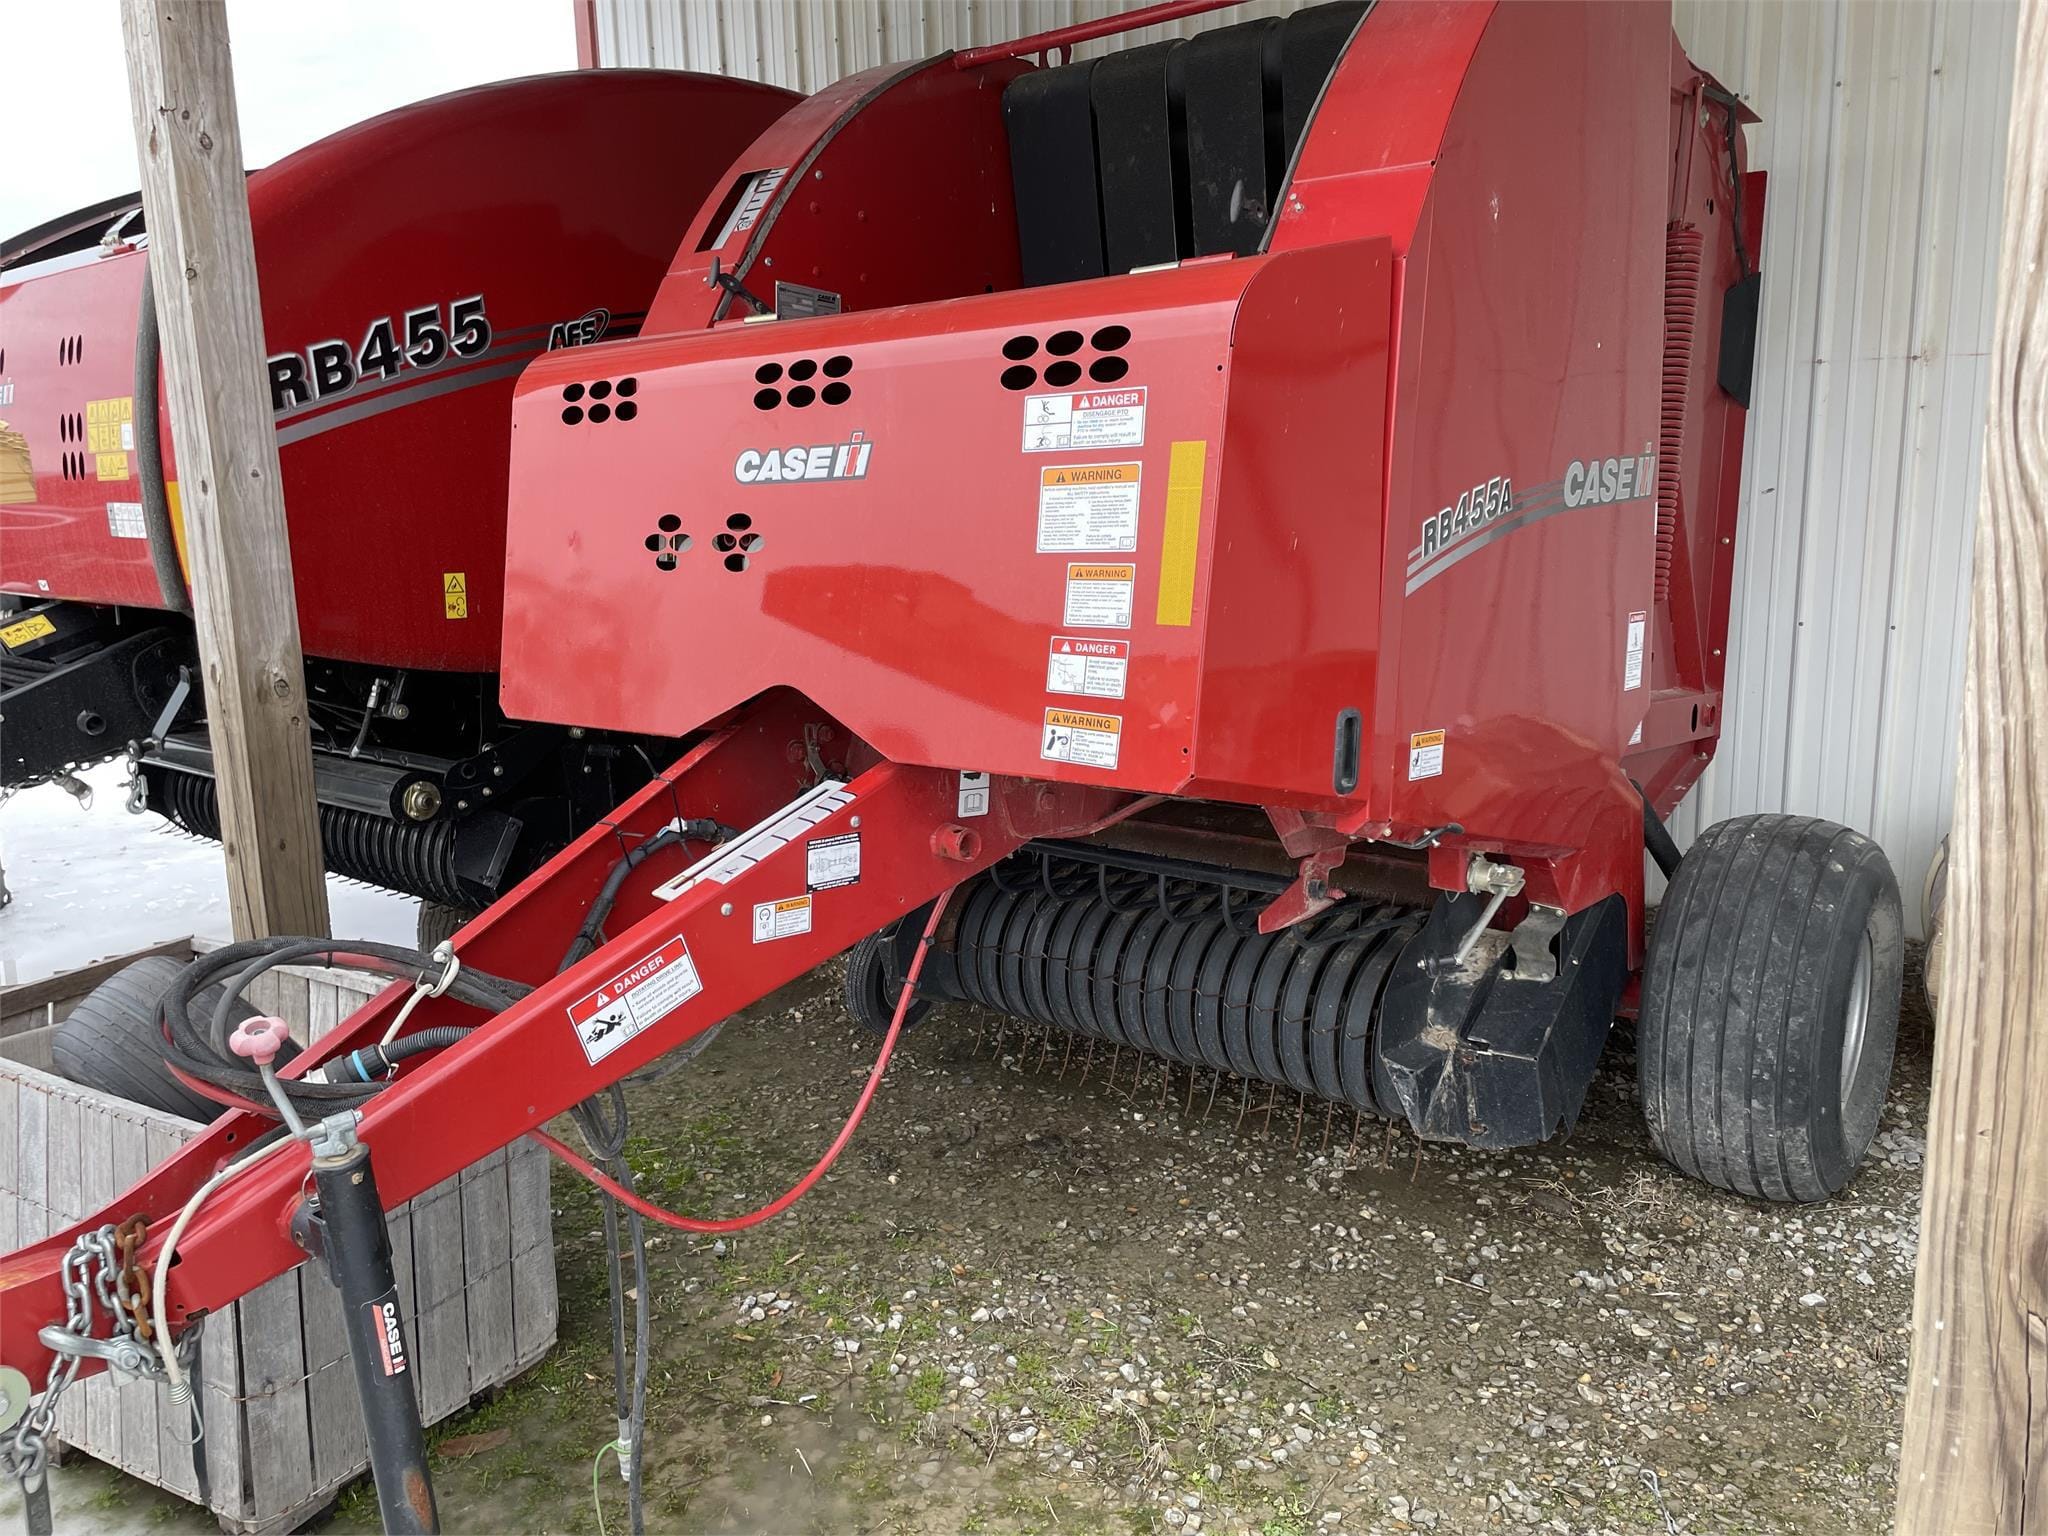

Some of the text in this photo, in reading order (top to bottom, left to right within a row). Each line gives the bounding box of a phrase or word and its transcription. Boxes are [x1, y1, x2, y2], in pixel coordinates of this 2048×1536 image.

[547, 316, 597, 352] AFS
[267, 294, 492, 414] RB455
[1092, 392, 1138, 407] DANGER
[735, 447, 833, 482] CASE
[1070, 469, 1121, 481] WARNING
[1563, 457, 1635, 508] CASE
[1422, 476, 1512, 559] RB455A
[1085, 569, 1127, 578] WARNING
[1075, 642, 1116, 654] DANGER
[1062, 714, 1110, 729] WARNING
[612, 953, 664, 995] DANGER
[383, 1302, 403, 1356] CASE
